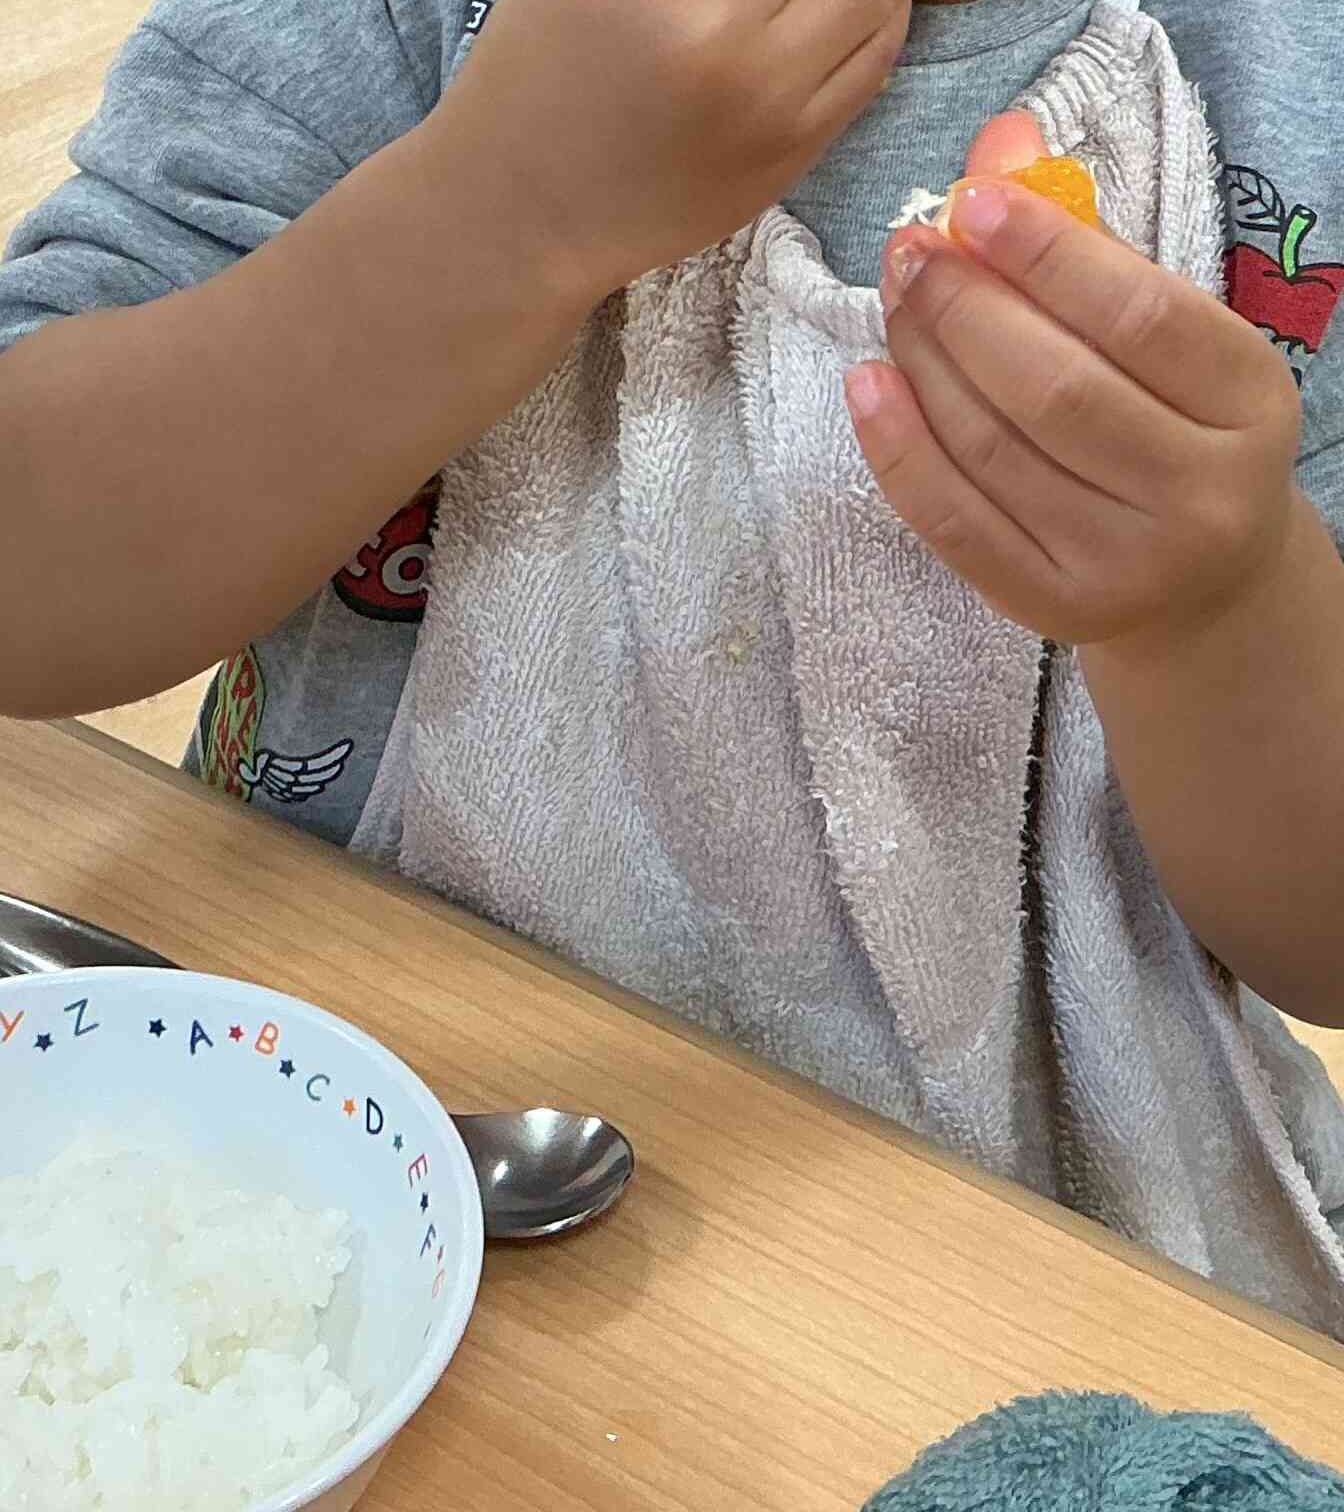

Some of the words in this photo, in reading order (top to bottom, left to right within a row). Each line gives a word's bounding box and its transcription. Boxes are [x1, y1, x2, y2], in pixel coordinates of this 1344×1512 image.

[64, 998, 99, 1036] Z
[190, 1019, 213, 1055] A
[255, 1021, 279, 1055] B
[306, 1074, 330, 1101] C
[366, 1096, 384, 1135] D
[408, 1153, 429, 1188] E
[420, 1224, 436, 1257] F
